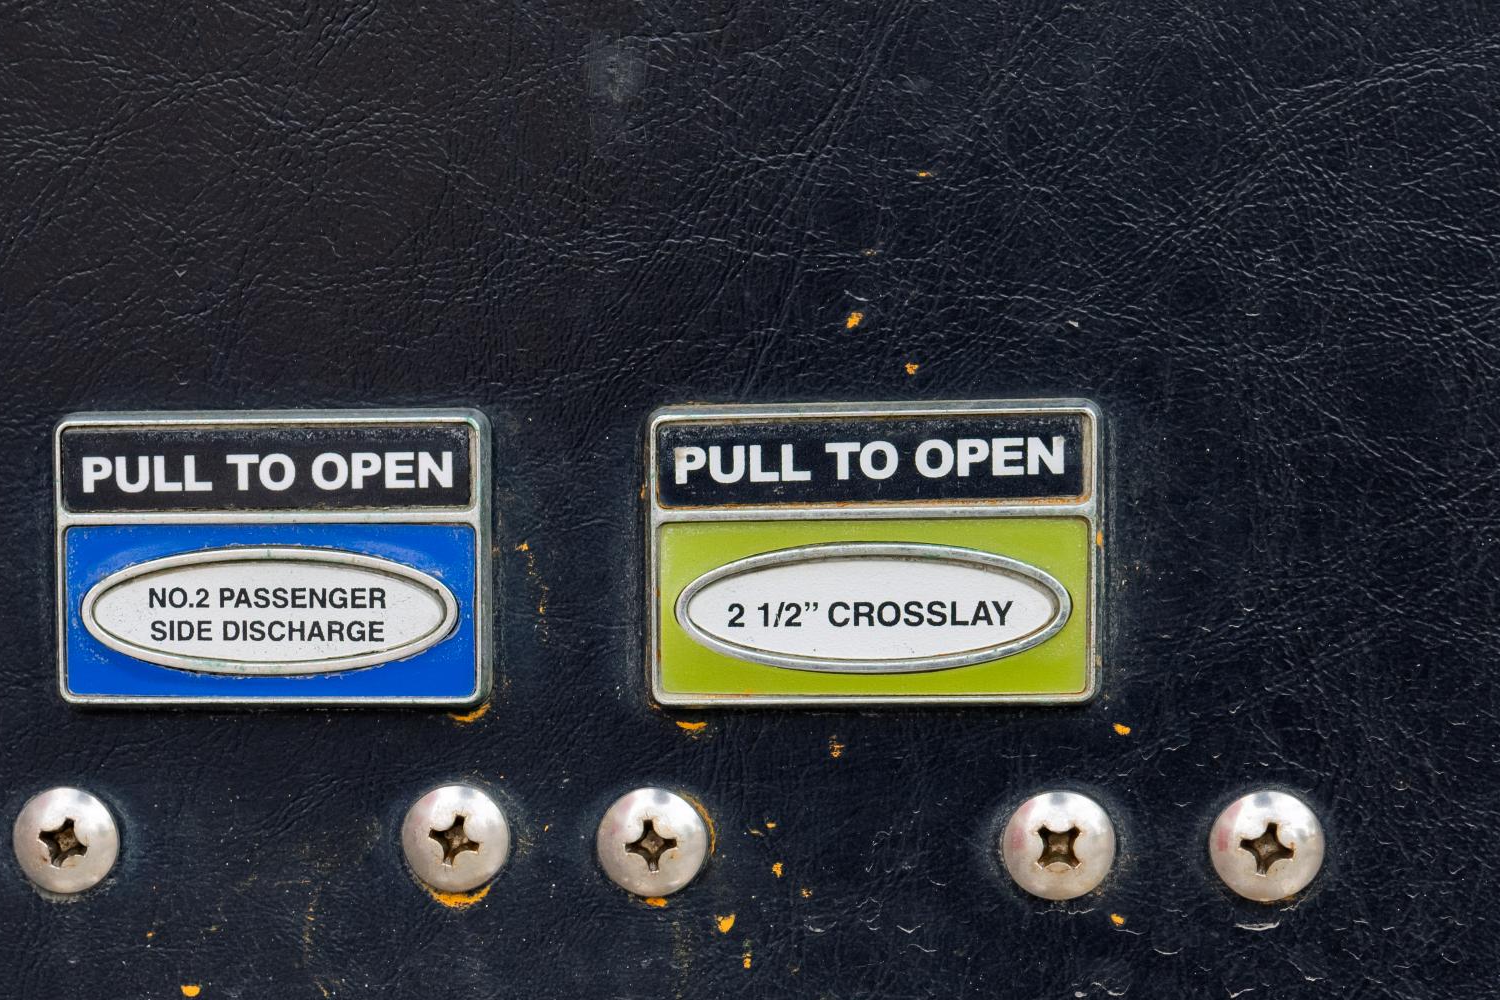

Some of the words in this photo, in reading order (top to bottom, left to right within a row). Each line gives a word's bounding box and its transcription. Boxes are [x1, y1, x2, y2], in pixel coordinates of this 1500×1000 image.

[82, 455, 212, 493] PULL
[227, 453, 295, 491] TO
[311, 452, 452, 491] OPEN
[674, 444, 811, 484] PULL
[825, 441, 899, 480] TO
[915, 436, 1065, 477] OPEN
[149, 587, 209, 609] NO.2
[219, 587, 386, 609] PASSENGER
[728, 603, 744, 627] 2
[828, 600, 1013, 627] CROSSLAY
[150, 620, 212, 642] SIDE
[223, 620, 384, 642] DISCHARGE
